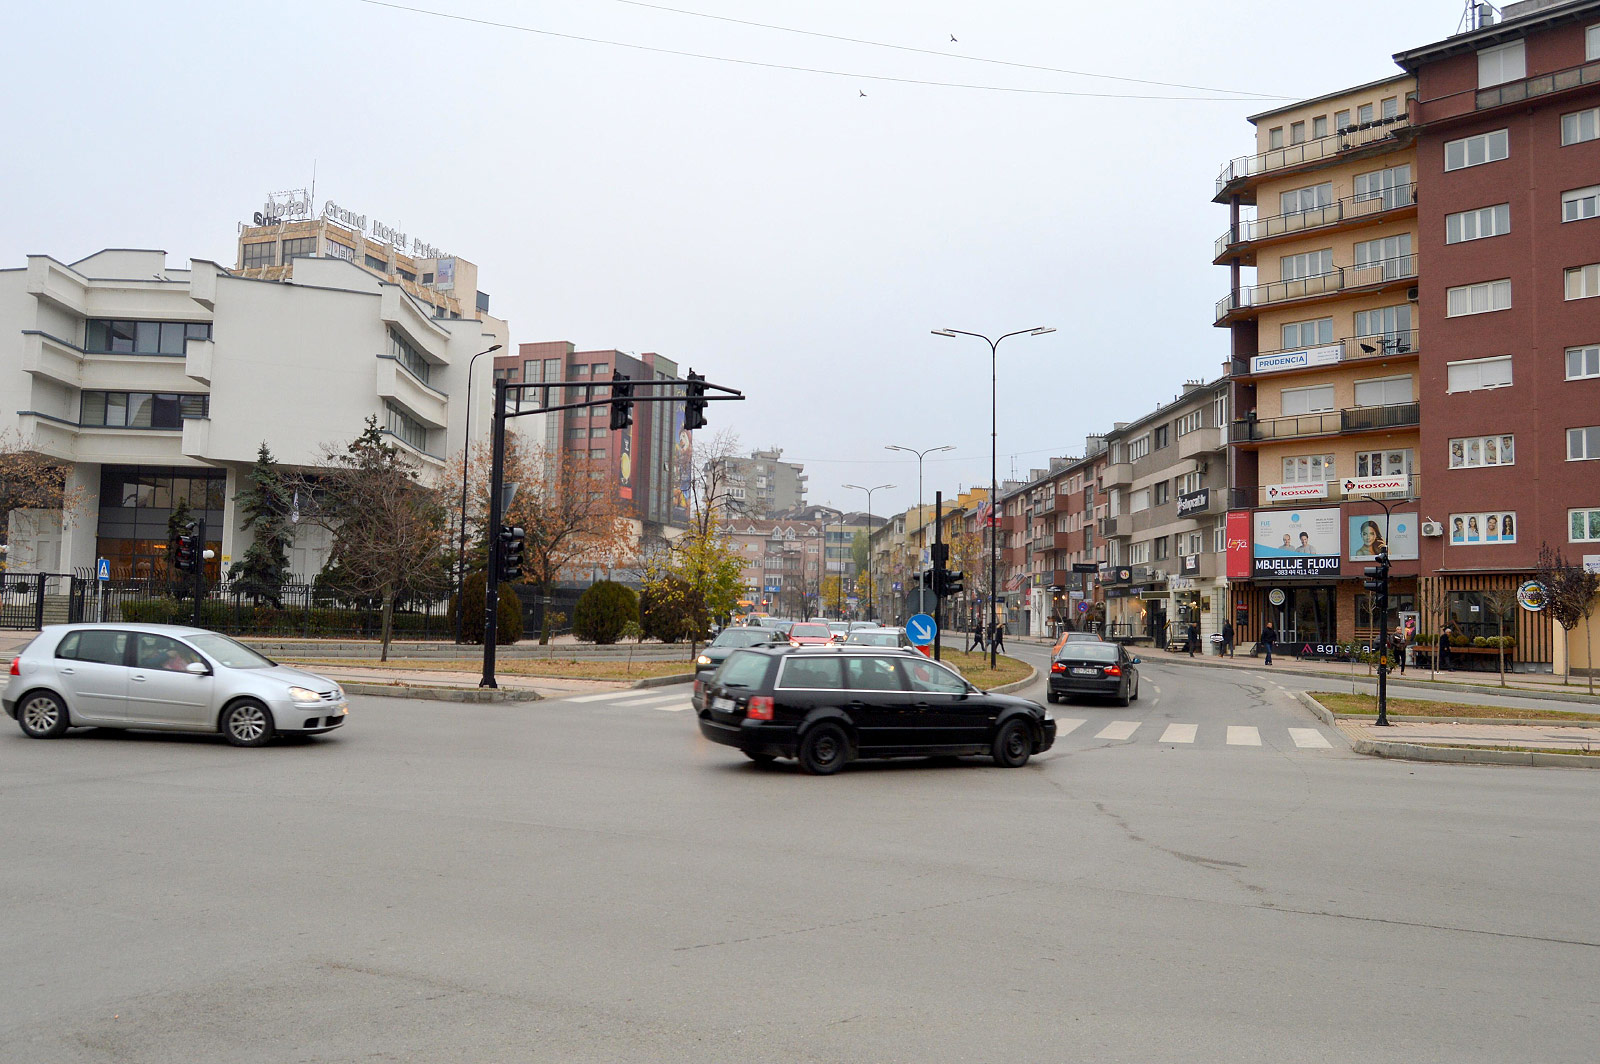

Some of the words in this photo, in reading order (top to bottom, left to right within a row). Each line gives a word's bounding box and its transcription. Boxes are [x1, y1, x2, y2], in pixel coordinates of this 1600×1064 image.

[264, 198, 308, 218] Hotel
[325, 200, 367, 230] Grand
[373, 220, 407, 248] Hotel
[1259, 355, 1305, 368] PRUDENCIA
[1255, 559, 1303, 570] MBJELLJE
[1307, 558, 1339, 569] FLOKU
